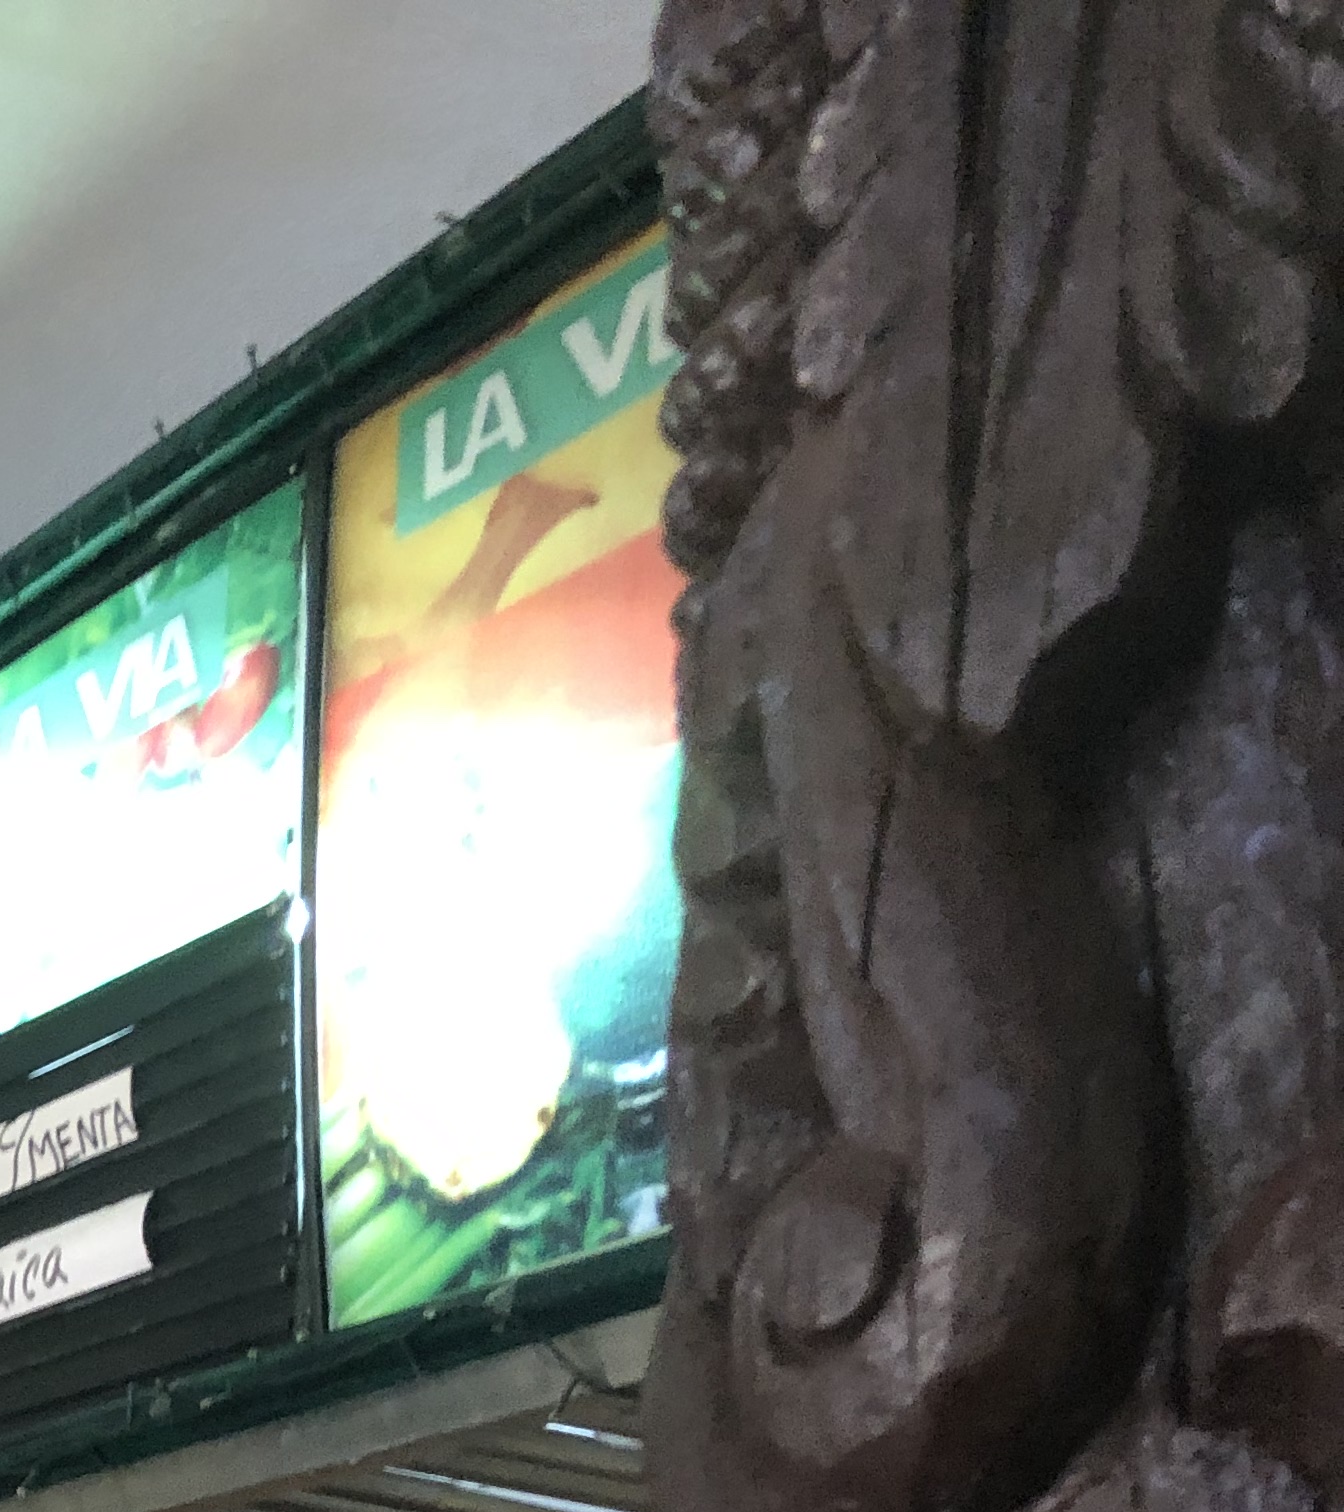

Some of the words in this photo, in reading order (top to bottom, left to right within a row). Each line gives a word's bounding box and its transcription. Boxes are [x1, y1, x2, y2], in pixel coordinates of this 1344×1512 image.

[422, 369, 529, 501] LA
[561, 265, 687, 399] VI
[75, 613, 199, 741] VIA
[28, 1098, 139, 1182] MENTA
